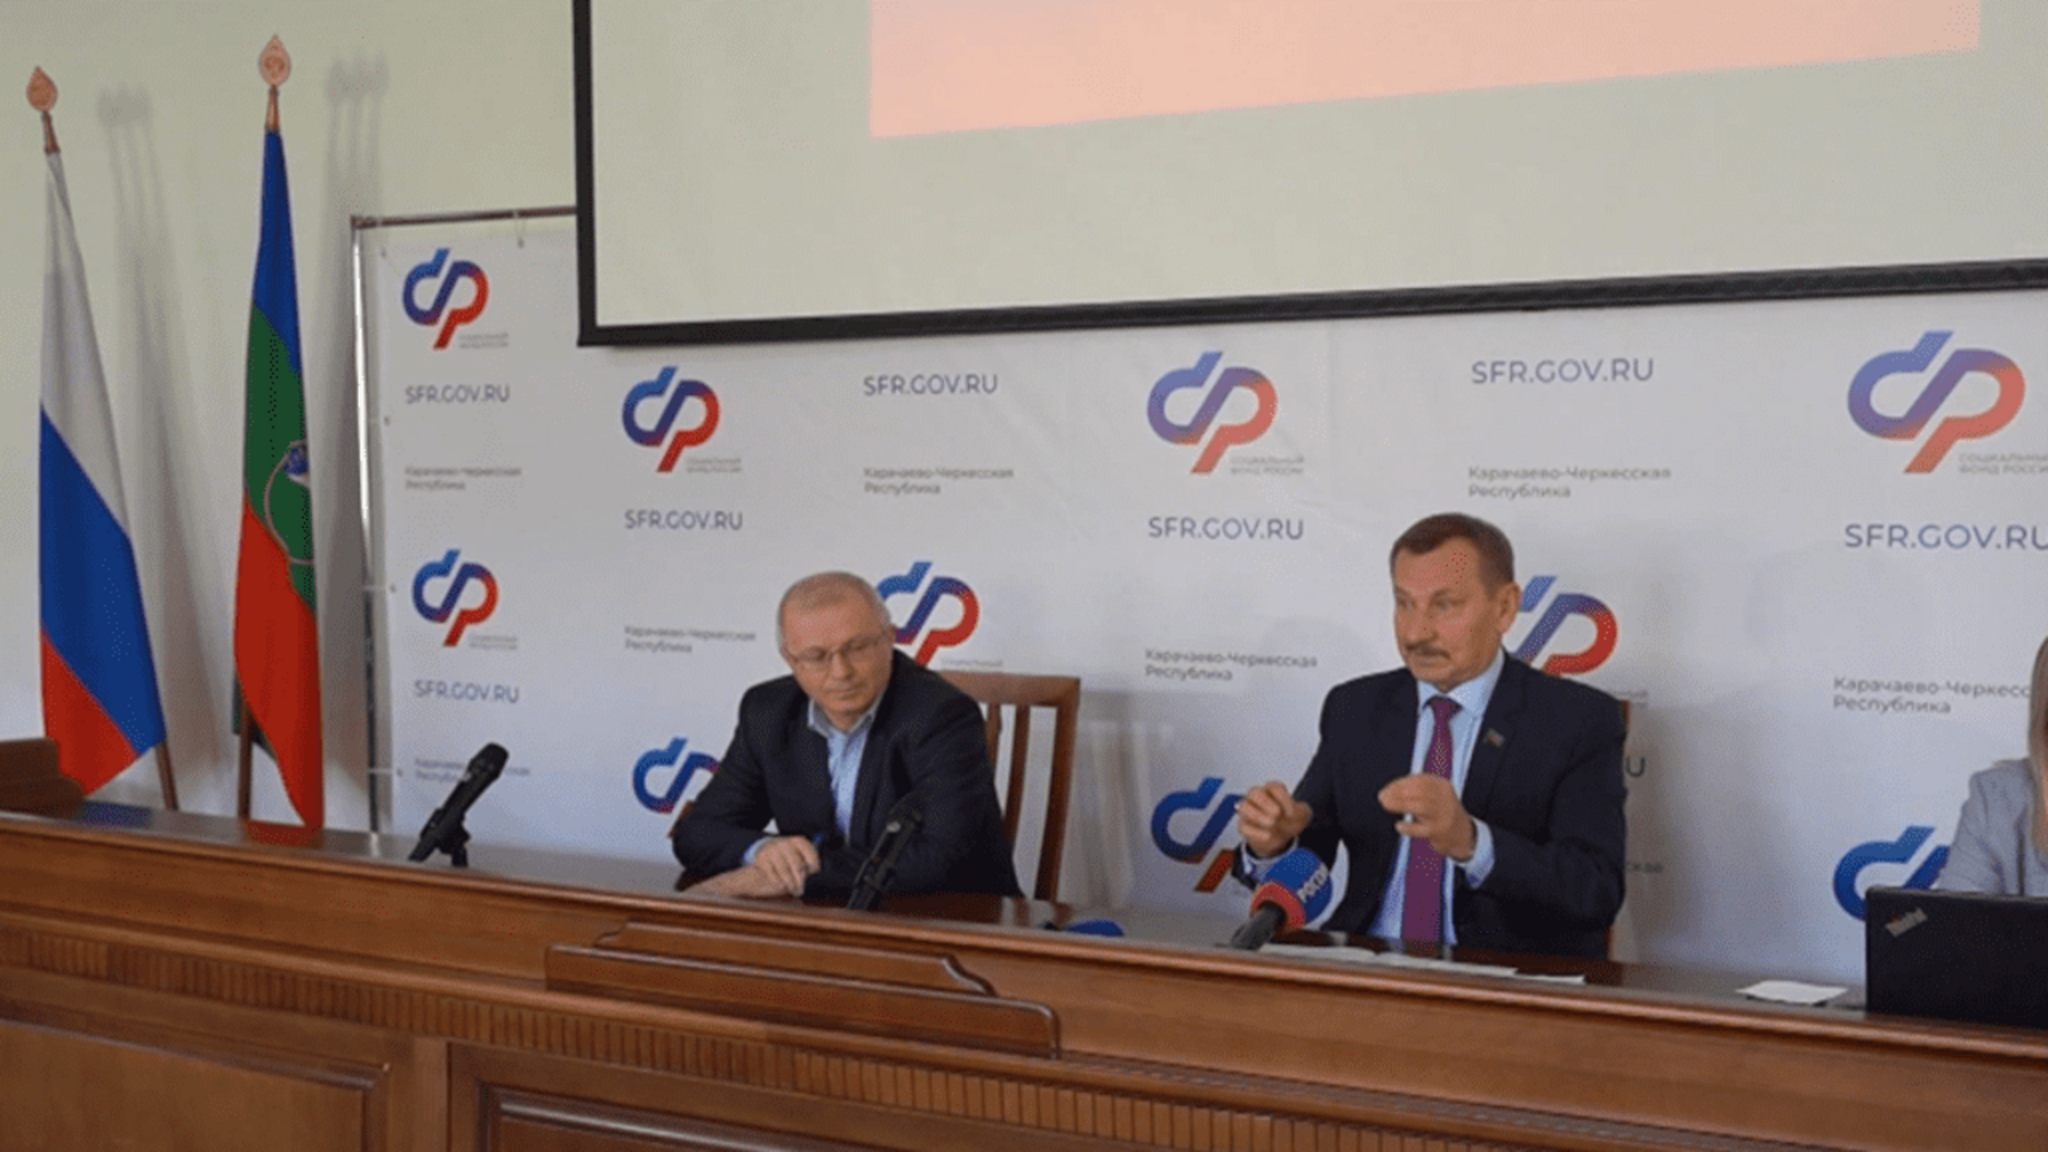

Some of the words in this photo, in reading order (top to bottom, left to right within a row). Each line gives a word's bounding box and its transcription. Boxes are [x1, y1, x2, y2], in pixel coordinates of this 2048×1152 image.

[1471, 358, 1654, 384] SFR.GOV.RU
[405, 384, 511, 403] SFR.GOV.RU
[863, 373, 998, 396] SFR.GOV.RU
[1958, 453, 2048, 463] СОЦИАЛЬНЫ
[1469, 465, 1671, 482] Карачаево-Черкесская
[2002, 464, 2048, 475] РОССИ
[1468, 482, 1571, 500] Республика
[624, 509, 743, 531] SFR.GOV.RU
[1148, 516, 1304, 540] SFR.GOV.RU
[1845, 523, 2048, 551] SFR.GOV.RU
[414, 679, 520, 704] SFR.GOV.RU
[1833, 676, 2031, 699] Карачаево-Черкесс
[1833, 695, 1952, 715] Республика
